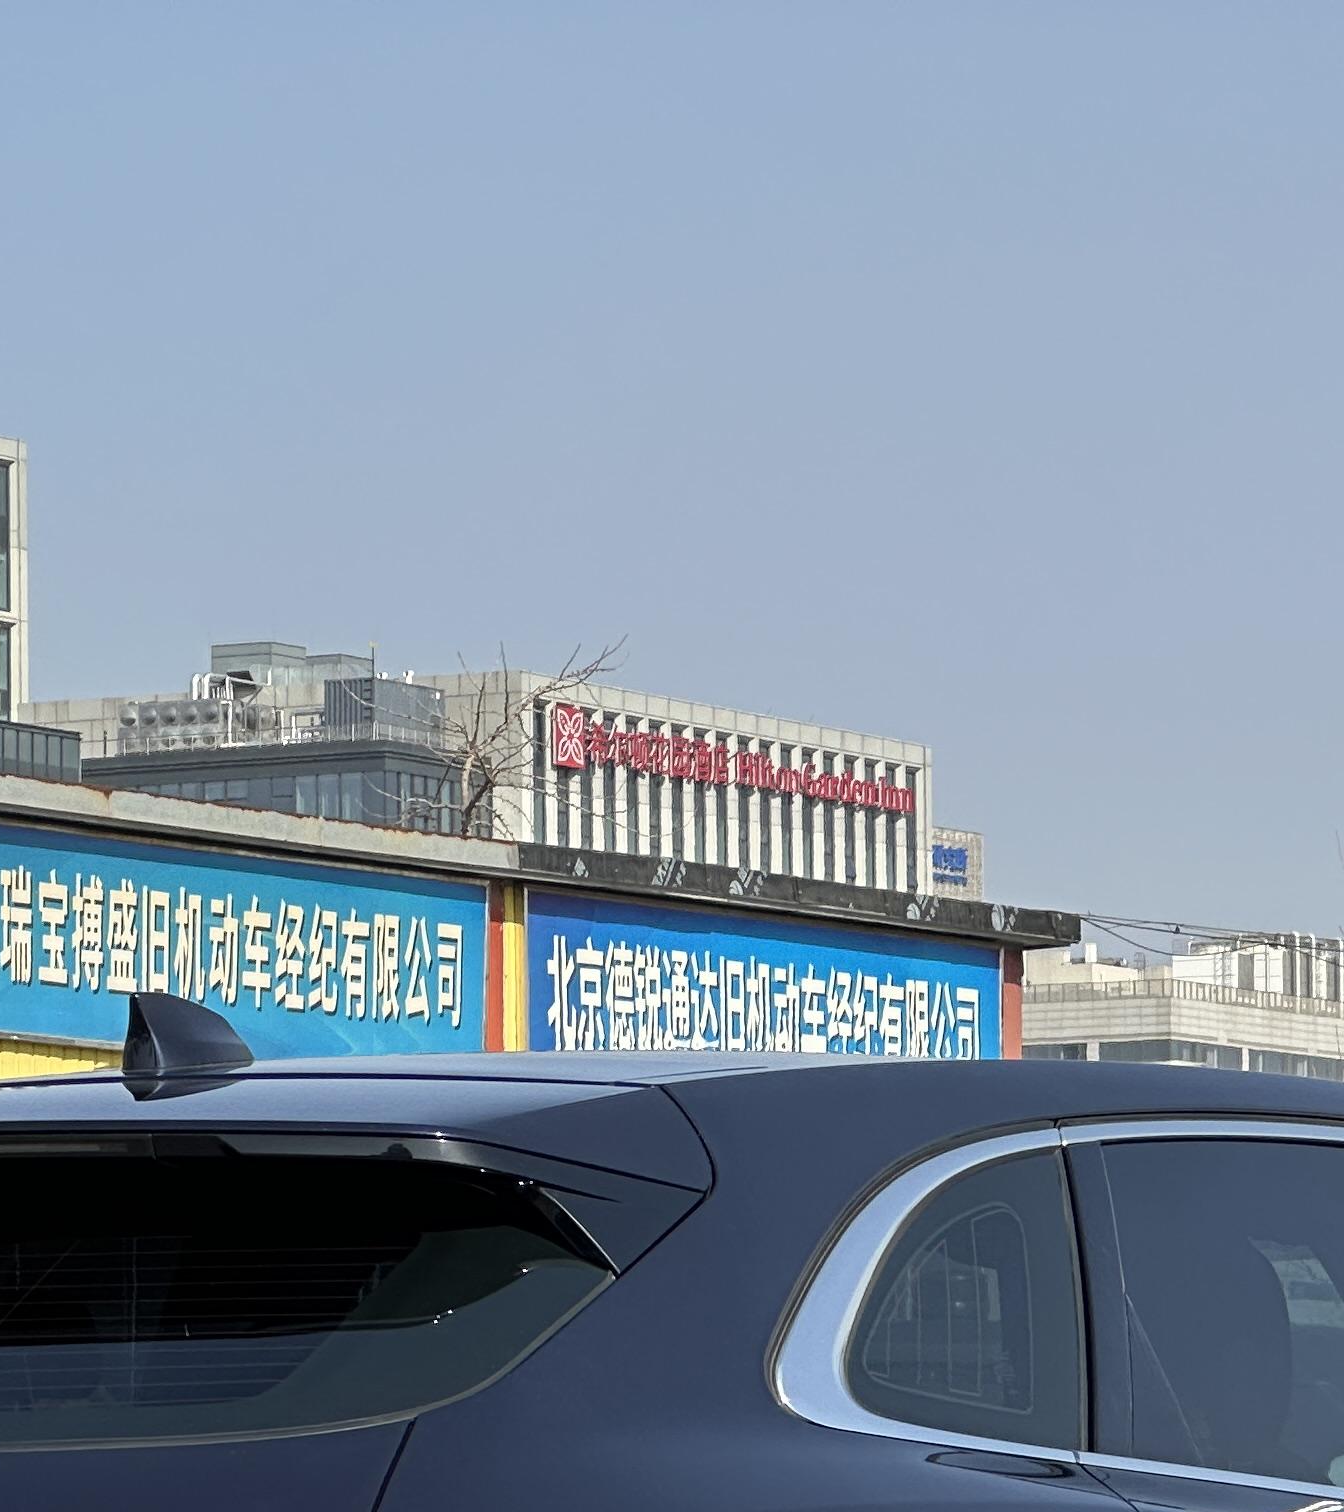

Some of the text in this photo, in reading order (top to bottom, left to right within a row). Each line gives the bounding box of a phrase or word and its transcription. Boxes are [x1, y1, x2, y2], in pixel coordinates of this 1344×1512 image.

[736, 751, 800, 794] Hilton
[547, 934, 980, 1061] 北京德锐通达旧机动车经纪有限公司
